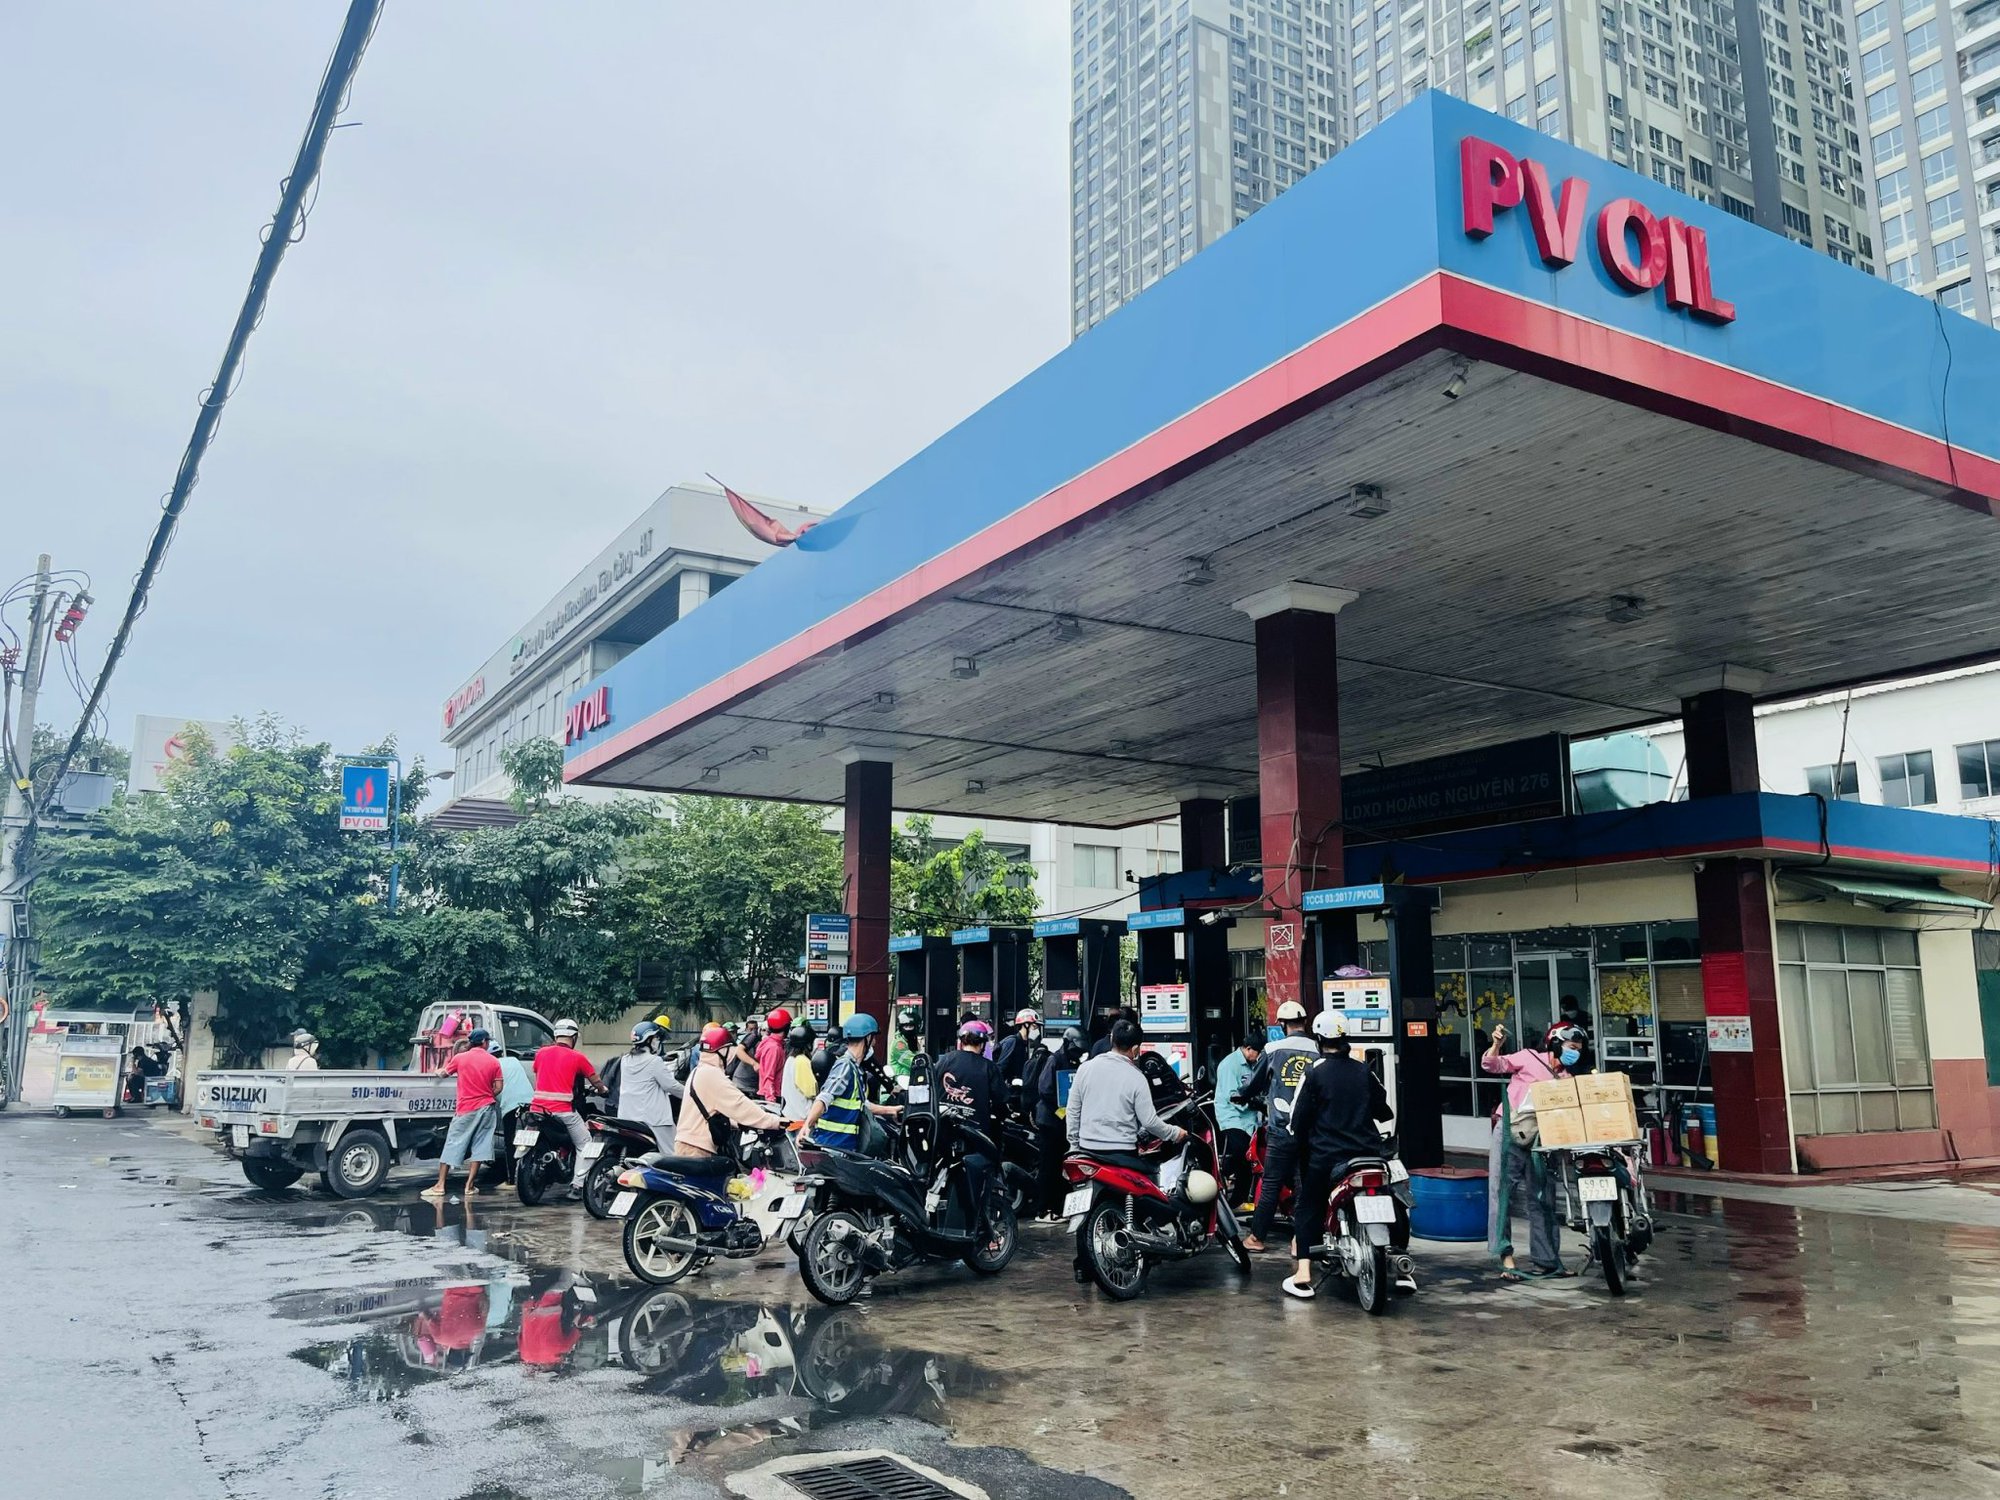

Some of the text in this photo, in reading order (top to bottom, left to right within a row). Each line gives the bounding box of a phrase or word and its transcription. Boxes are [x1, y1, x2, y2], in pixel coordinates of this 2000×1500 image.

[1461, 135, 1736, 326] PV OIL
[565, 685, 610, 746] PV OIL
[1520, 772, 1549, 791] 276
[344, 817, 383, 828] PV OIL
[1306, 894, 1324, 906] TCCS
[211, 1086, 267, 1104] SUZUKI
